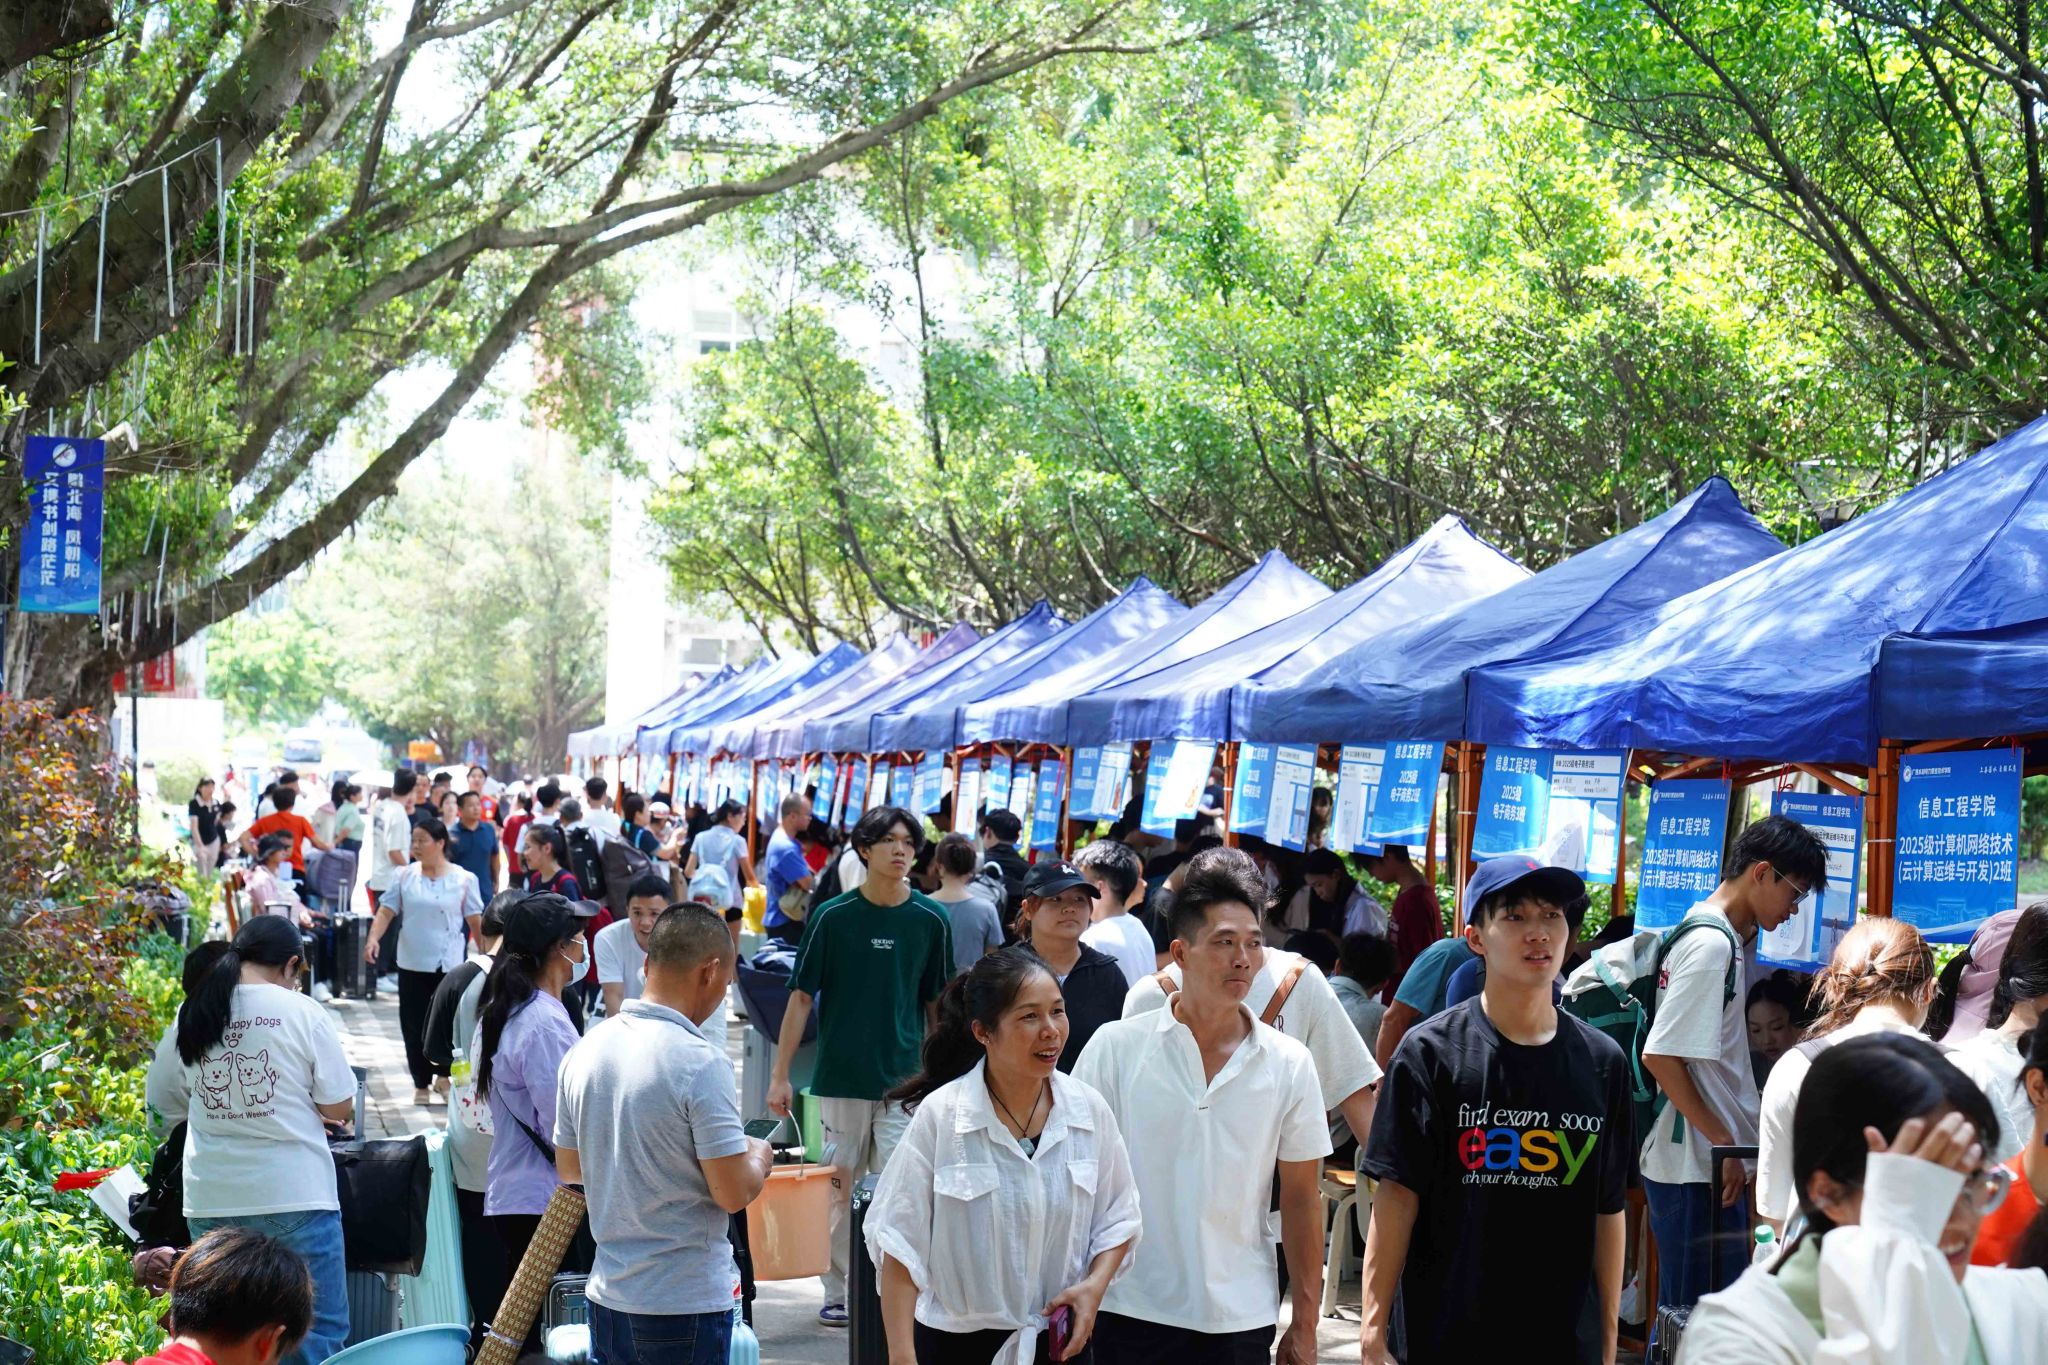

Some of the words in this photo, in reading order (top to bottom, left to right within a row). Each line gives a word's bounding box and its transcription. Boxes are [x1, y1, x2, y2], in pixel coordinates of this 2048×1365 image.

[64, 529, 82, 578] 凤朝阳
[1395, 744, 1434, 760] 信息工程学院
[1495, 755, 1537, 775] 信息工程学院
[1501, 785, 1522, 802] 2025级
[1493, 802, 1526, 823] 电子商务3班
[1822, 806, 1851, 818] 信息工程学院
[1919, 794, 1996, 819] 信息工程学院
[1660, 817, 1710, 837] 信息工程学院
[1899, 832, 2013, 856] 2025级计算机网络技术
[1645, 848, 1718, 869] 2025级计算机网络技术
[1642, 868, 1716, 893] (云计算运维与开发)1班
[1898, 860, 2012, 884] (云计算运维与开发)2班
[255, 1016, 281, 1028] Dogs
[245, 1108, 275, 1119] Weekend
[1493, 1108, 1550, 1128] exam
[1559, 1112, 1601, 1133] sooo
[1458, 1127, 1598, 1185] easy
[1503, 1170, 1559, 1190] thoughts.
